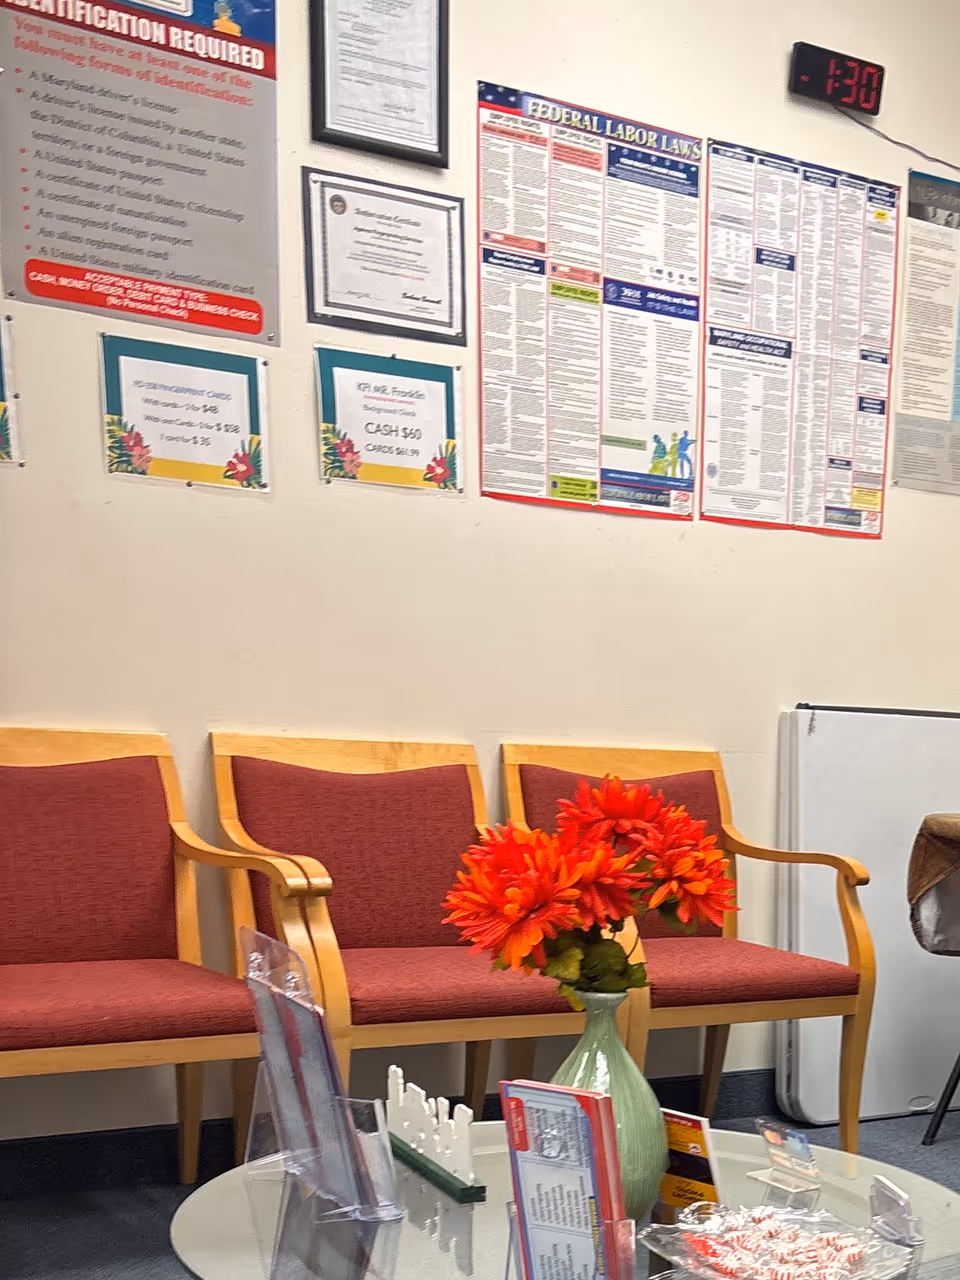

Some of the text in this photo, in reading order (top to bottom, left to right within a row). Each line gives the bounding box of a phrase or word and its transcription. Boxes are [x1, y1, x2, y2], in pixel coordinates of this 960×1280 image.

[12, 16, 43, 35] You
[168, 26, 265, 70] REQUIRED
[826, 59, 879, 110] 1:30
[528, 100, 702, 160] FEDERAL LABOR LAWS
[364, 422, 399, 438] CASH
